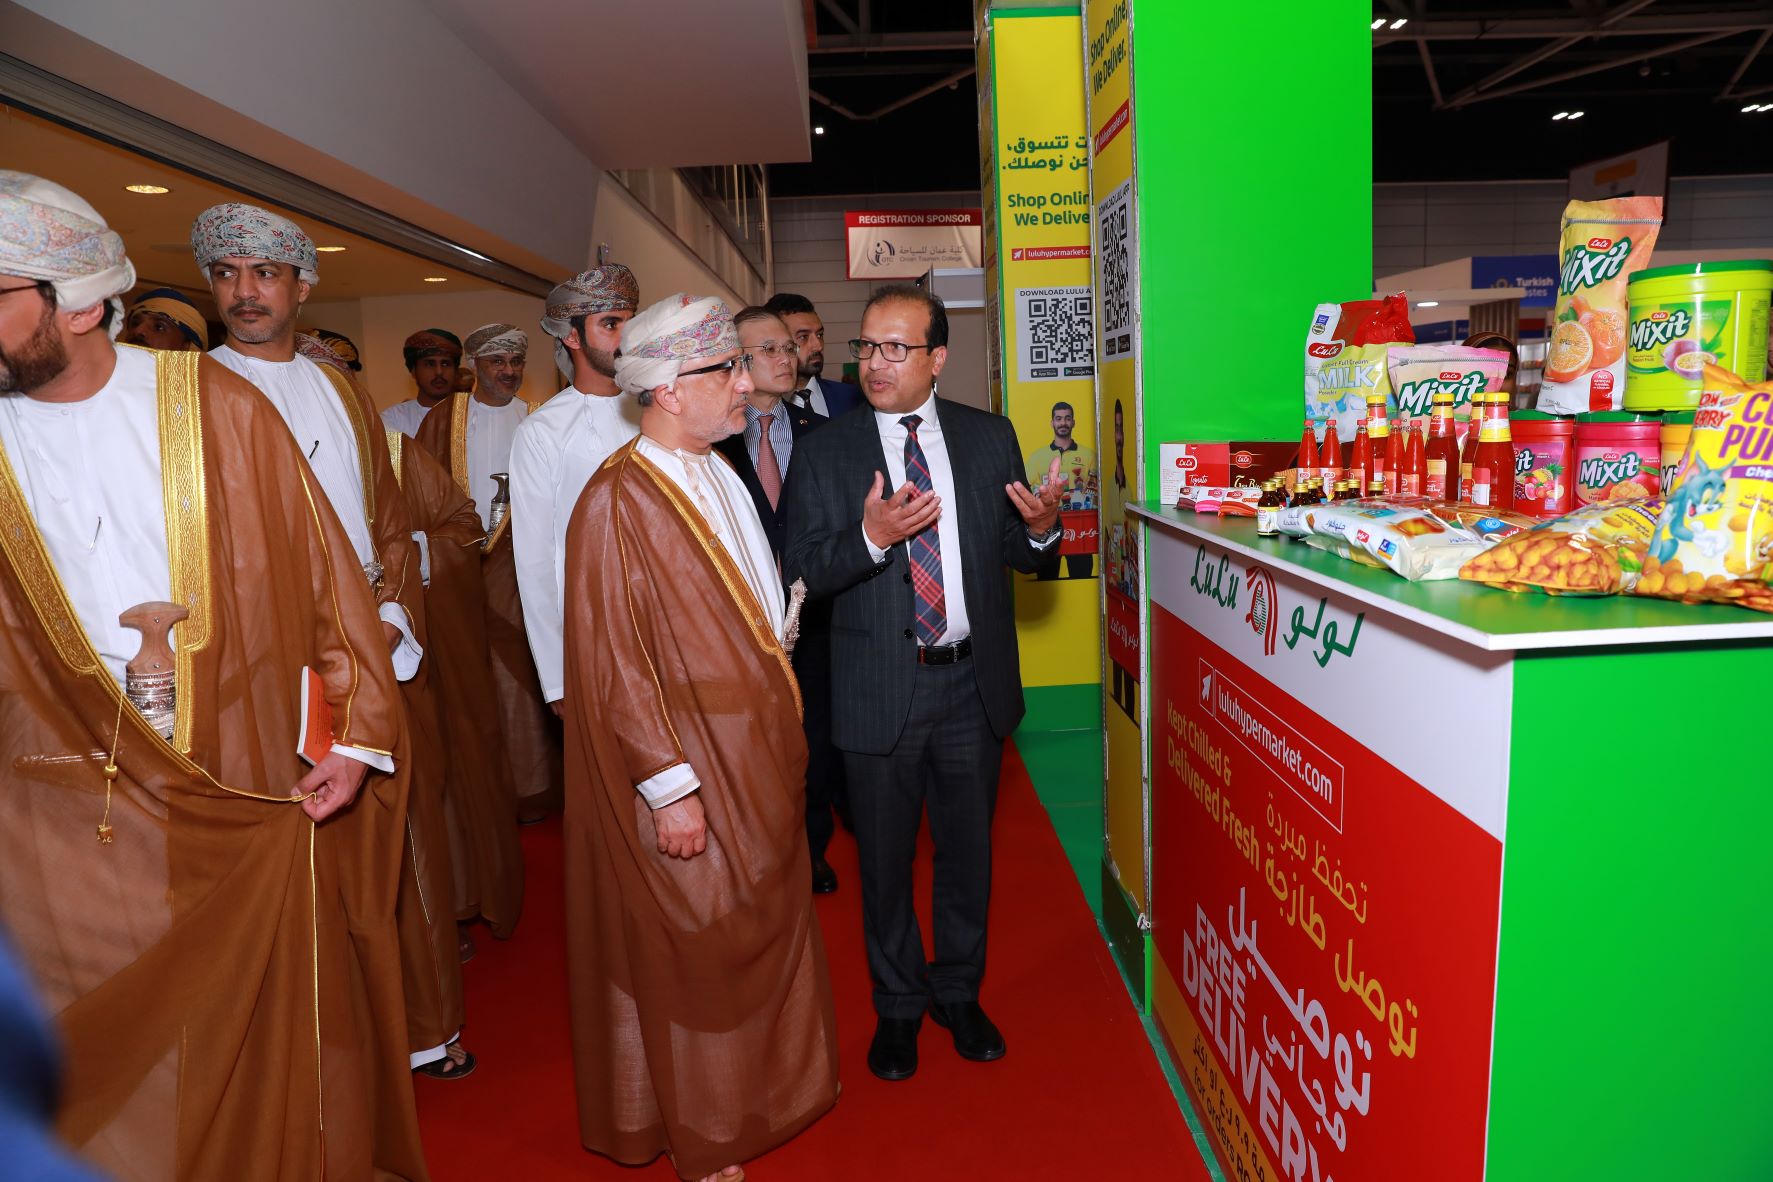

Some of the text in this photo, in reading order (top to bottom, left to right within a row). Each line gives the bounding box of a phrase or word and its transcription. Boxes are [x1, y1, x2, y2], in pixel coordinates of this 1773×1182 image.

[1090, 33, 1104, 66] Shop
[1094, 69, 1102, 96] We
[1002, 154, 1064, 171] نوصلك.
[1008, 190, 1090, 208] Shop Onlin
[858, 214, 971, 224] REGISTRATION SPONSOR
[1014, 210, 1090, 226] We Delive
[1028, 246, 1090, 258] luluhypermarket.c
[1516, 277, 1553, 286] Turkish
[1312, 345, 1339, 356] LuLu
[1318, 366, 1376, 389] MILK
[1694, 410, 1733, 427] ERRY
[1189, 474, 1208, 484] Tomato
[1580, 454, 1640, 486] Mixit
[1190, 544, 1240, 610] LuLu
[1282, 597, 1366, 668] لولو
[1168, 698, 1232, 786] Kept Chilled &
[1218, 684, 1333, 804] luluhypermarket.com
[1168, 735, 1260, 872] Delivered Fresh
[1266, 790, 1368, 924] تحفظ مبردة
[1196, 902, 1246, 1024] FREE
[1264, 842, 1418, 1060] توصل طازجة
[1228, 886, 1372, 1116] توصيل
[1263, 1014, 1347, 1153] مجاني
[1194, 1066, 1206, 1095] for
[1206, 1099, 1234, 1164] orders
